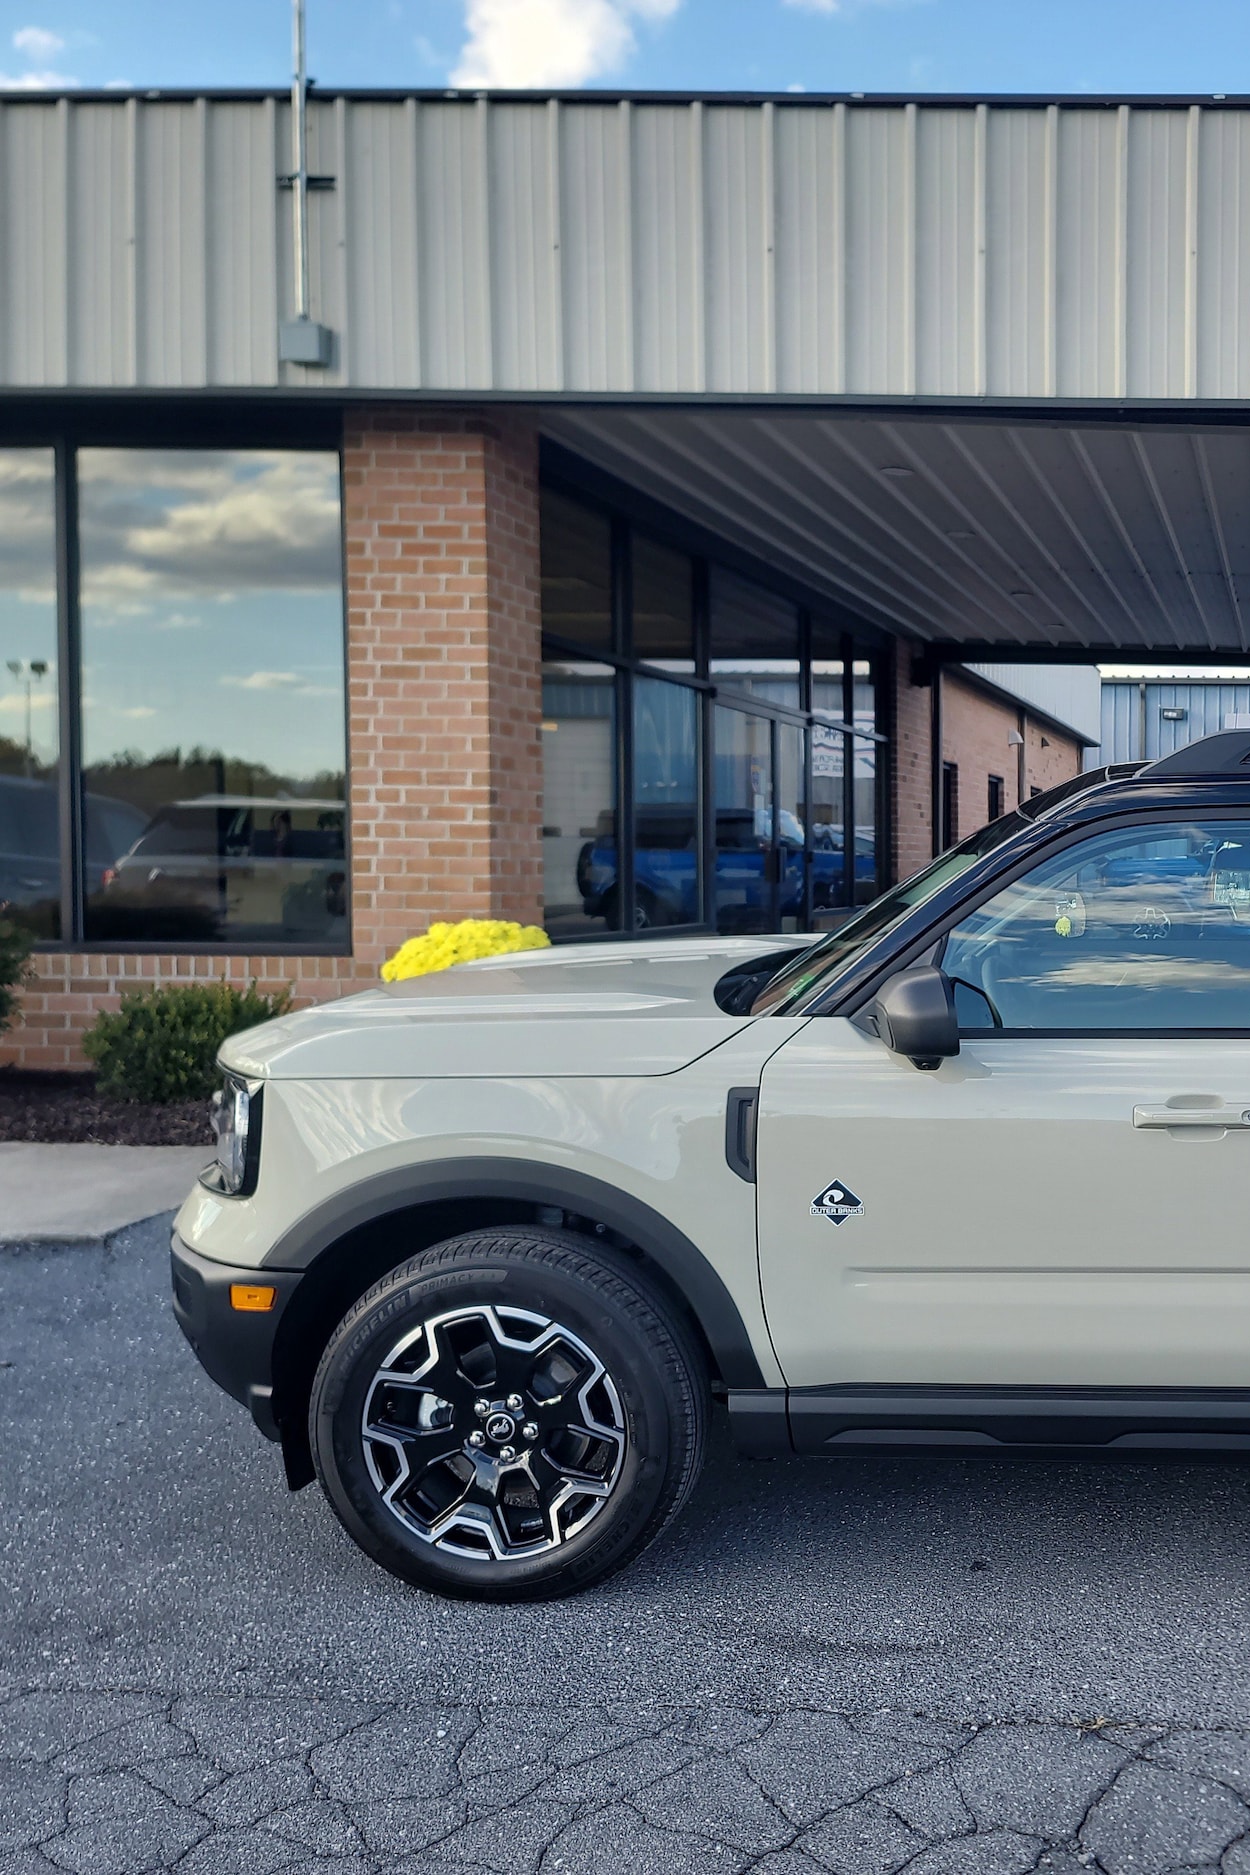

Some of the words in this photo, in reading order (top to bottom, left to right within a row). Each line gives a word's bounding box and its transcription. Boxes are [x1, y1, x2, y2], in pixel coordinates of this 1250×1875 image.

[812, 1207, 836, 1215] OUTER
[838, 1207, 863, 1215] BANKS
[339, 1293, 410, 1372] MICHELIN
[420, 1272, 475, 1292] PRIMACY
